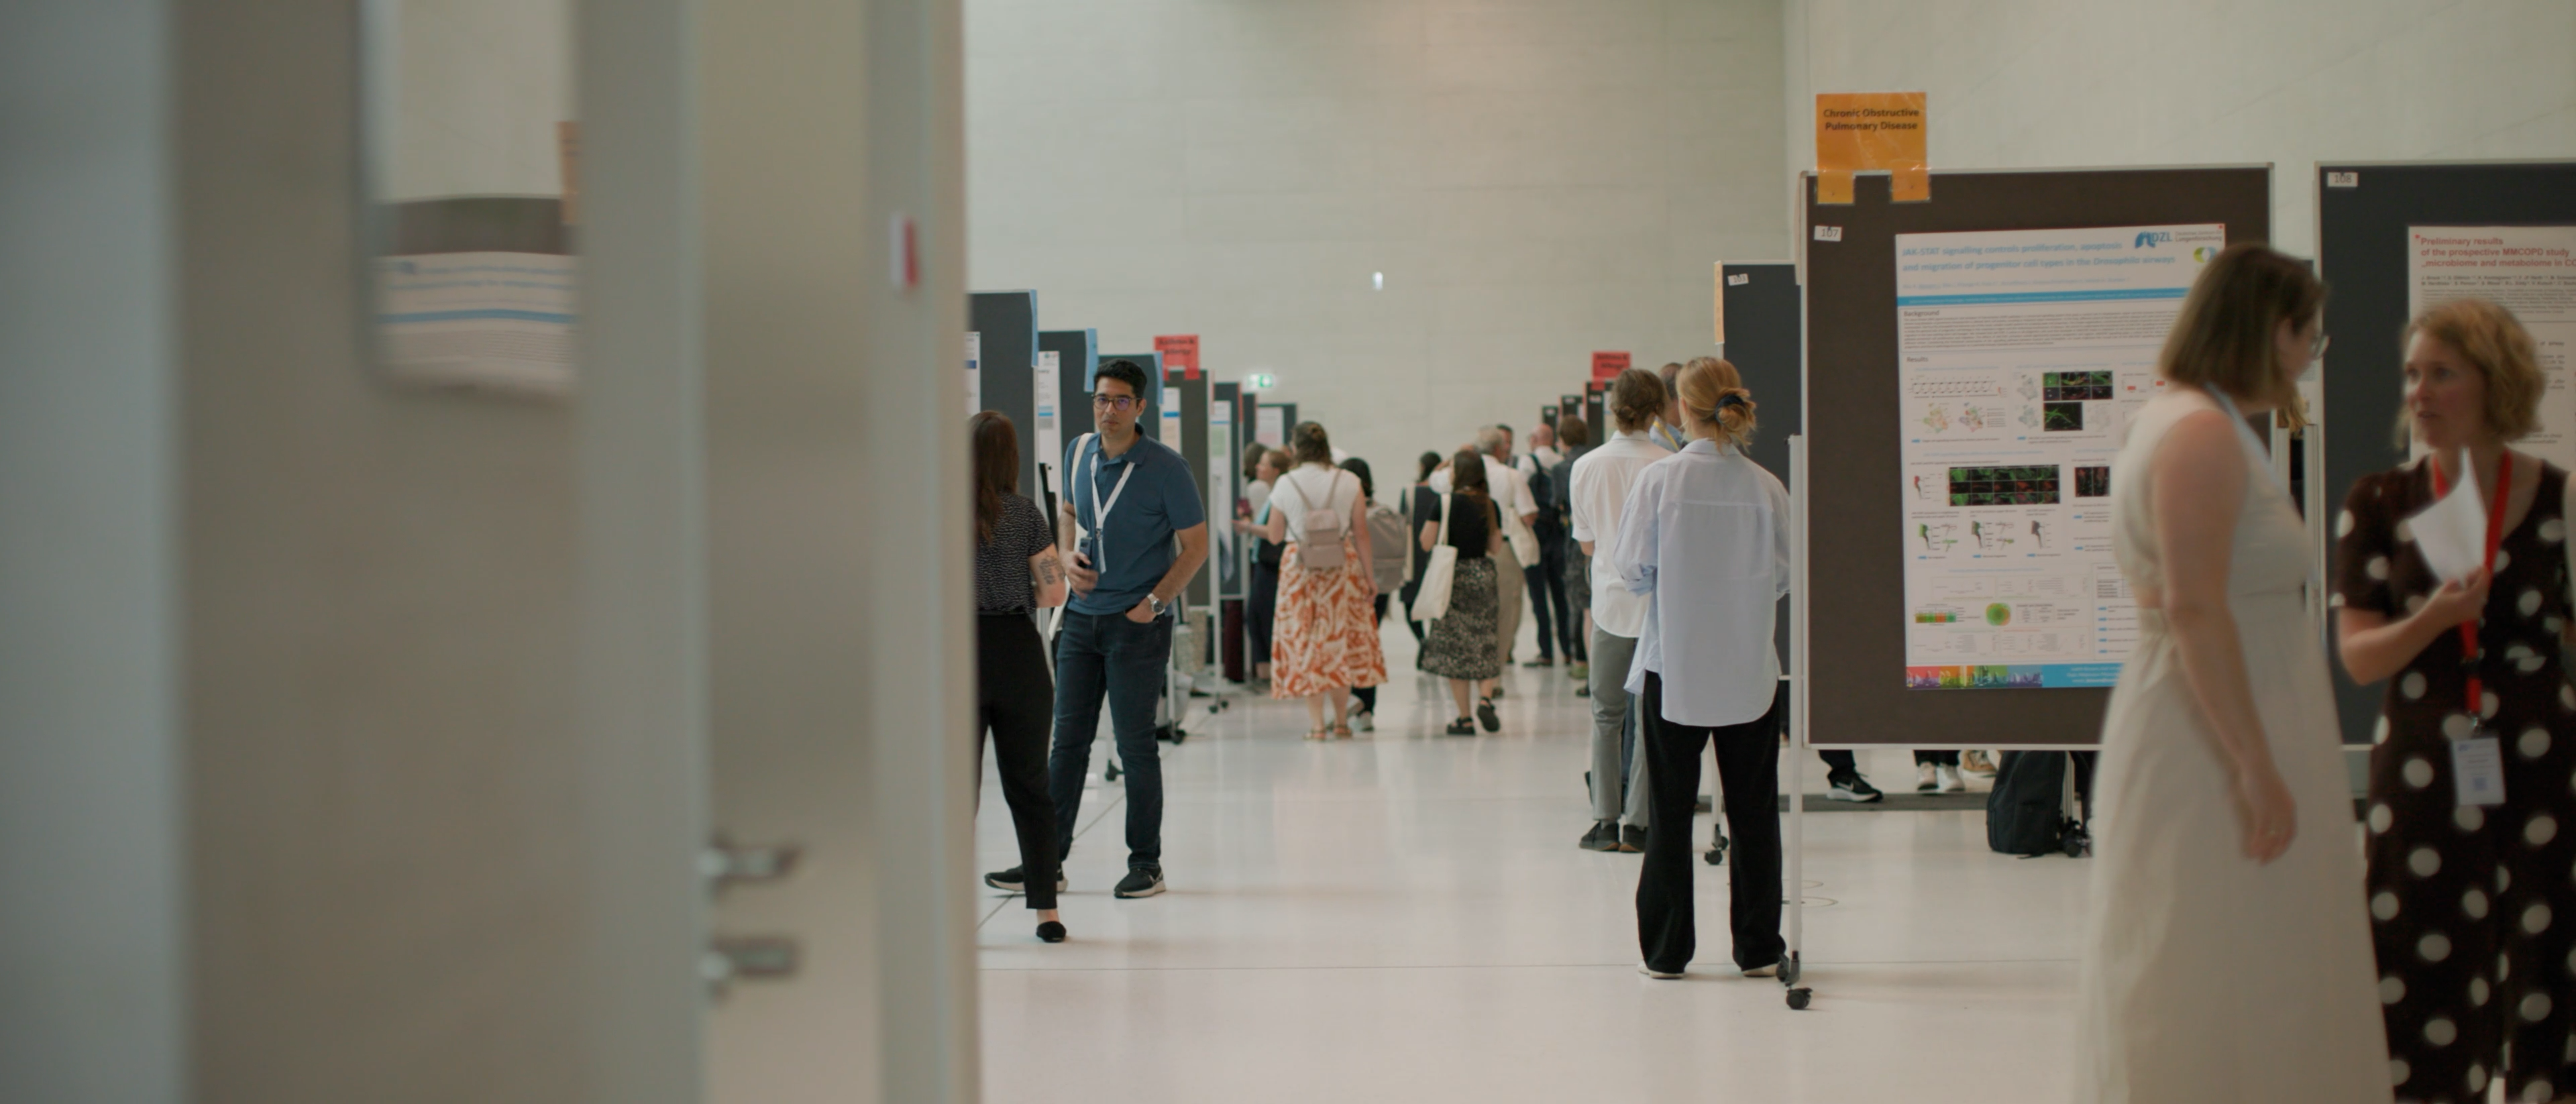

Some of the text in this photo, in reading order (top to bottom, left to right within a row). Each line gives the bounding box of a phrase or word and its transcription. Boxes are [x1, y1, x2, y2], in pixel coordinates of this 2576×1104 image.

[1823, 109, 1919, 117] Chronic Obstructive
[1825, 121, 1917, 131] Pulmonary Disease
[2334, 174, 2352, 184] 108
[1821, 229, 1839, 237] 107
[2420, 237, 2504, 247] Preliminary results
[1985, 245, 2020, 254] controls
[2420, 248, 2570, 258] of the prospective MMCOPD study
[1902, 263, 1919, 271] and
[1921, 262, 1962, 272] migration
[1964, 261, 1974, 270] of
[2077, 257, 2092, 266] the
[2480, 259, 2496, 267] and
[2499, 259, 2552, 267] metabolome
[1904, 310, 1939, 318] Background
